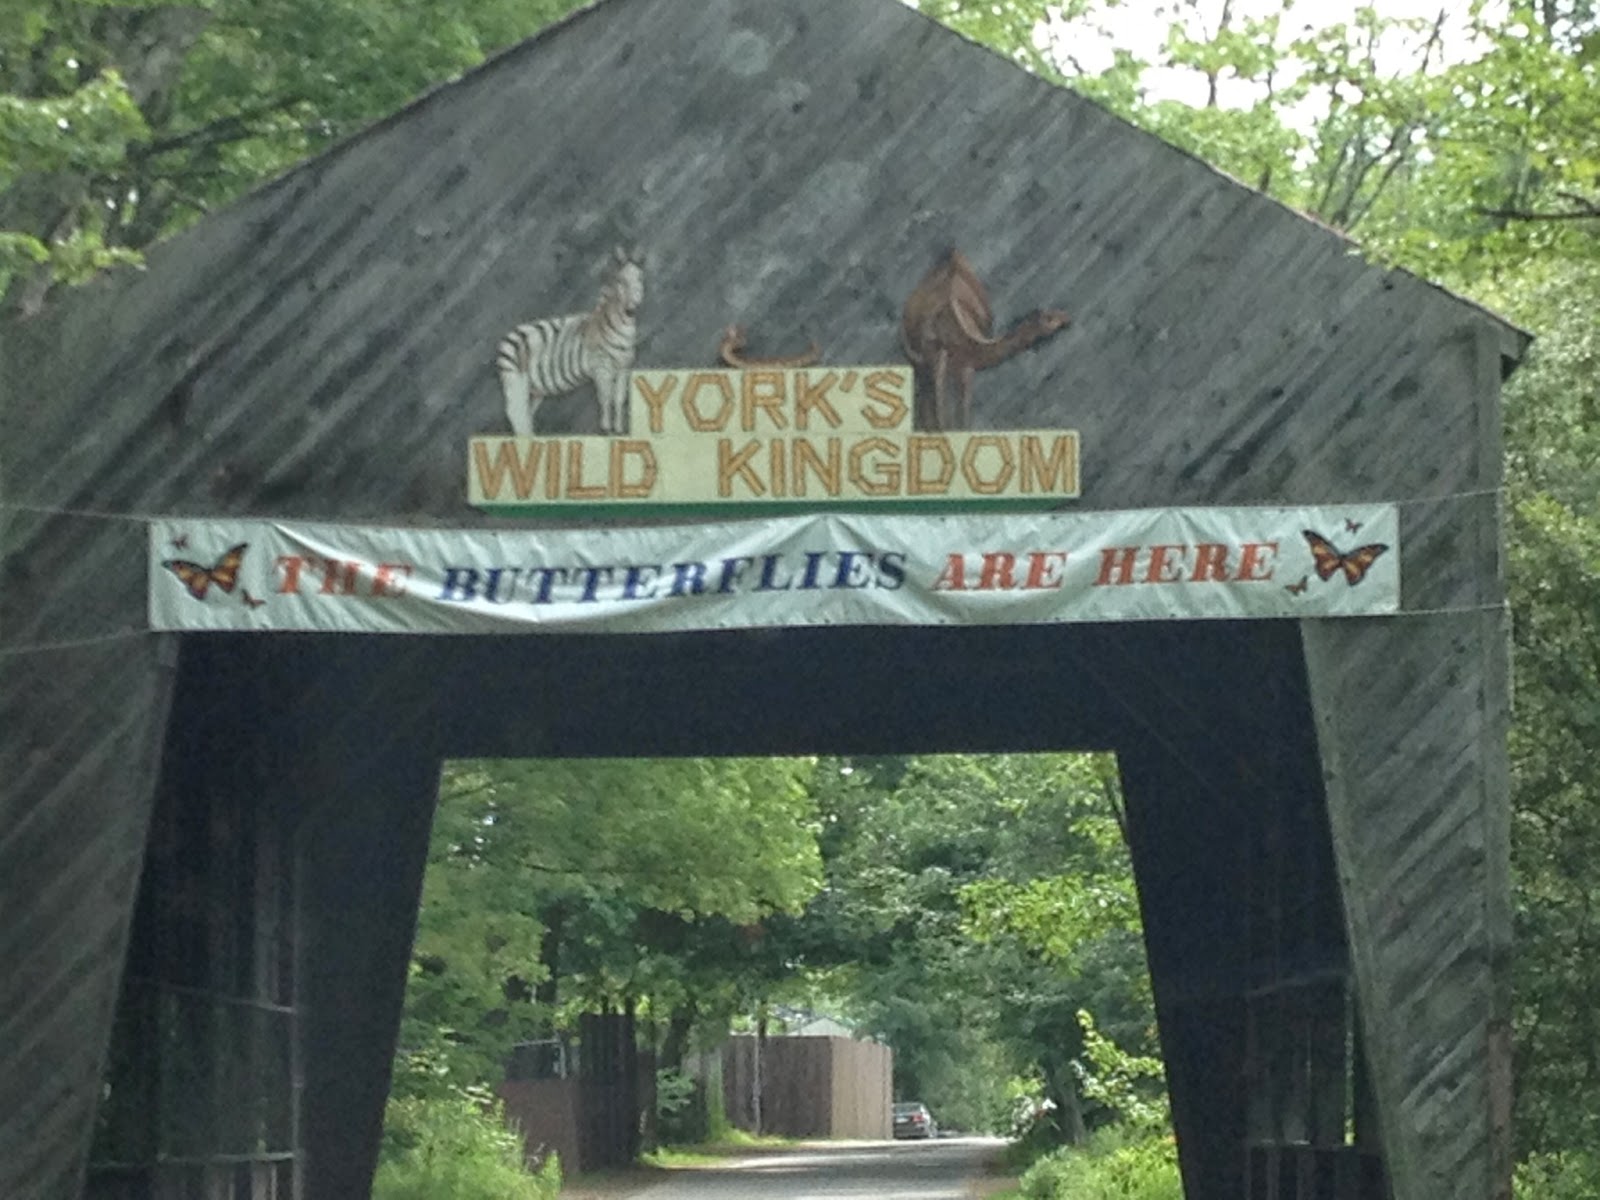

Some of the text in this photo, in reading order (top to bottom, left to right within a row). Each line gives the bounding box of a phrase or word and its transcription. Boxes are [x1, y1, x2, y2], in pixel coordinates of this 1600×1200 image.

[634, 371, 909, 433] YORK'S
[473, 435, 1075, 499] WILD KINGDOM
[273, 542, 1279, 604] THE BUTTERFLIES ARE HERE
